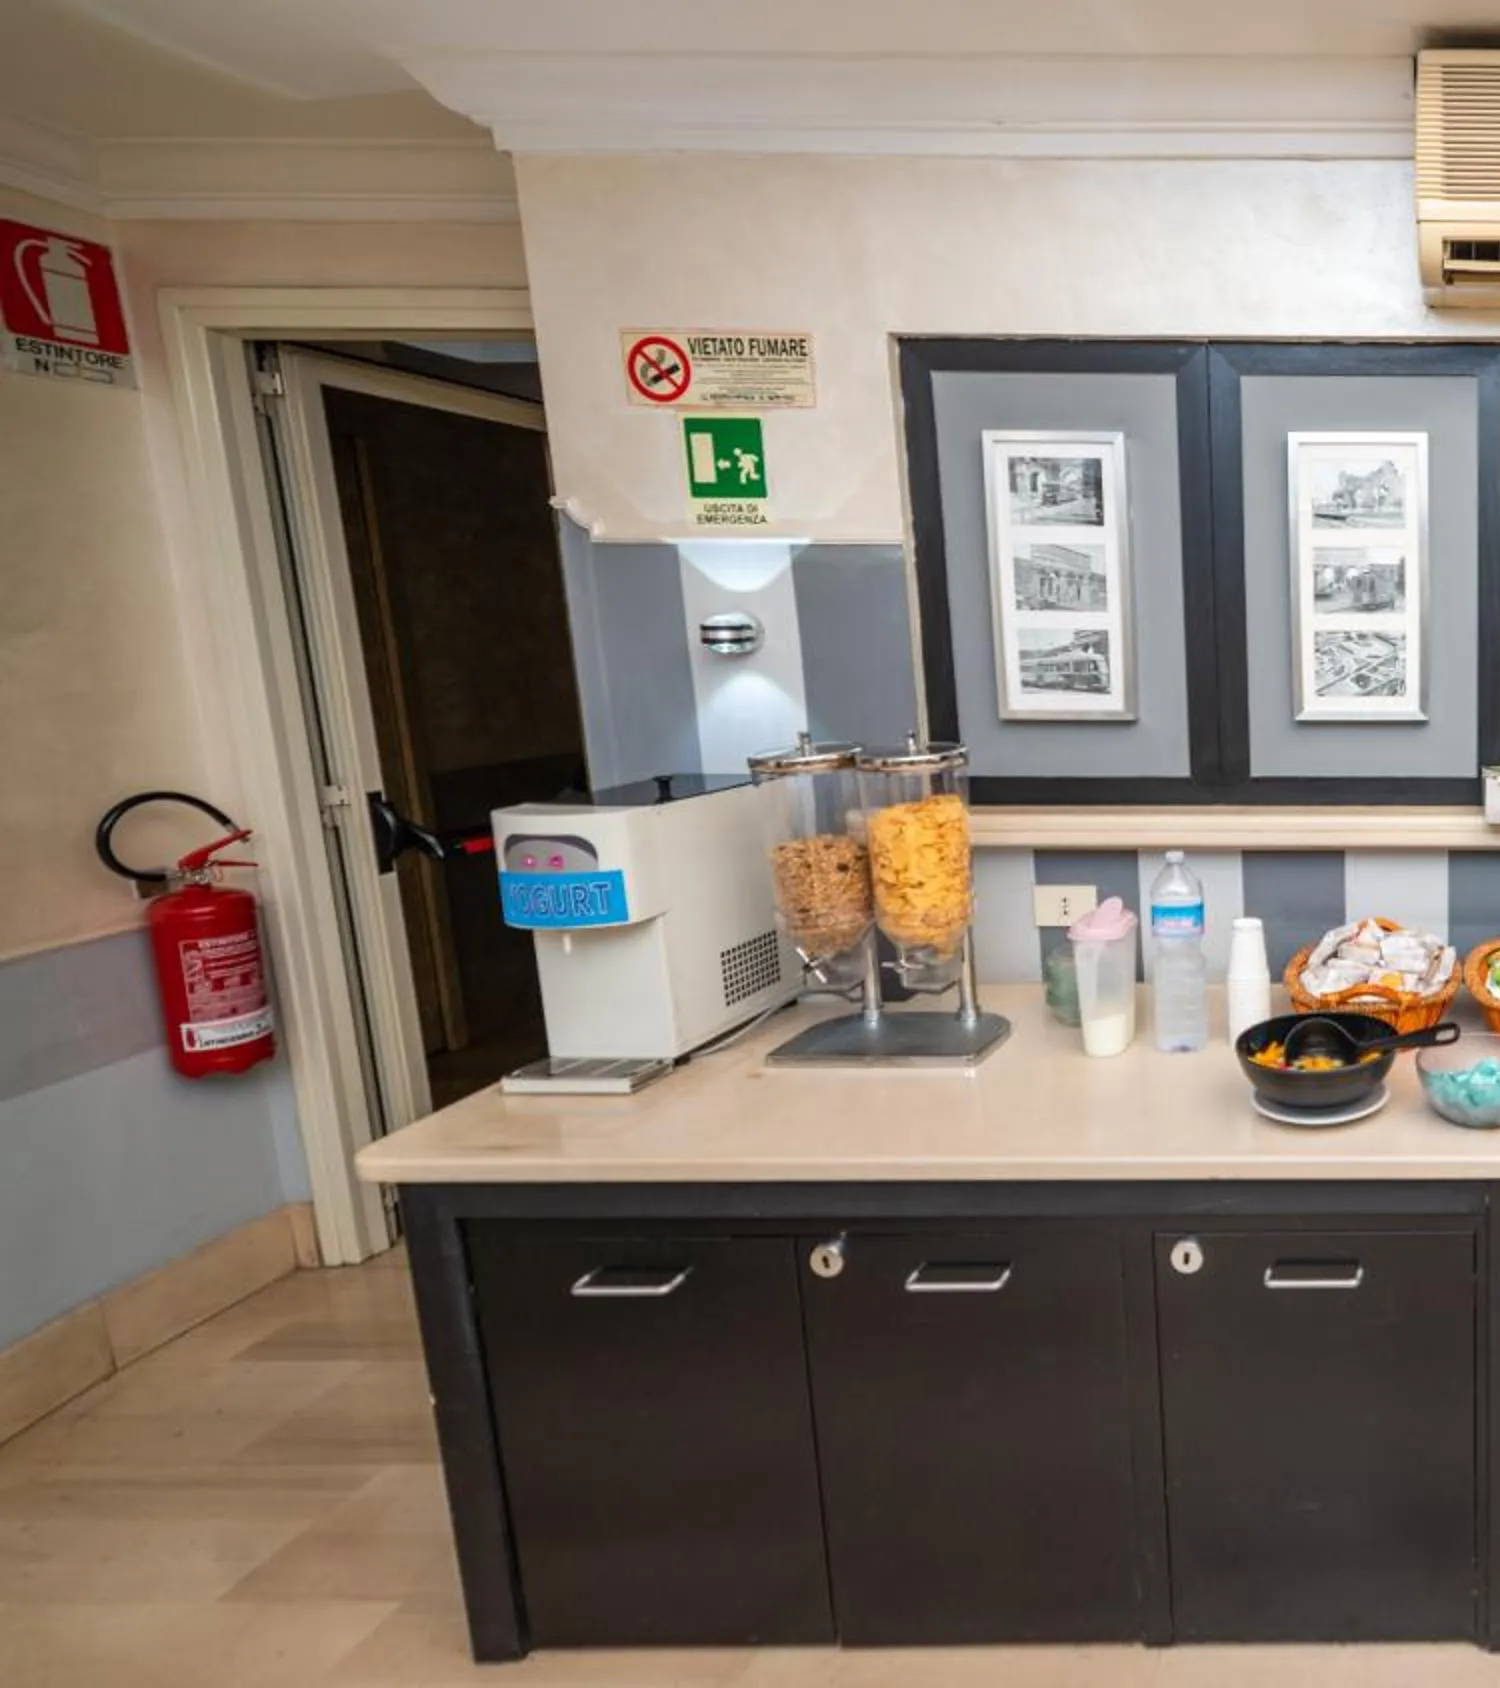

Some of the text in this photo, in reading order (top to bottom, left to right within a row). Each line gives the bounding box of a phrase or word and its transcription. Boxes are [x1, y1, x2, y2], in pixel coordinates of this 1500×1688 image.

[15, 337, 125, 370] ESTINTORE
[687, 337, 808, 357] VIETATO FUMARE
[703, 503, 759, 513] USCITA DI
[696, 514, 768, 525] EMERGENZA
[509, 881, 611, 918] YOGURT
